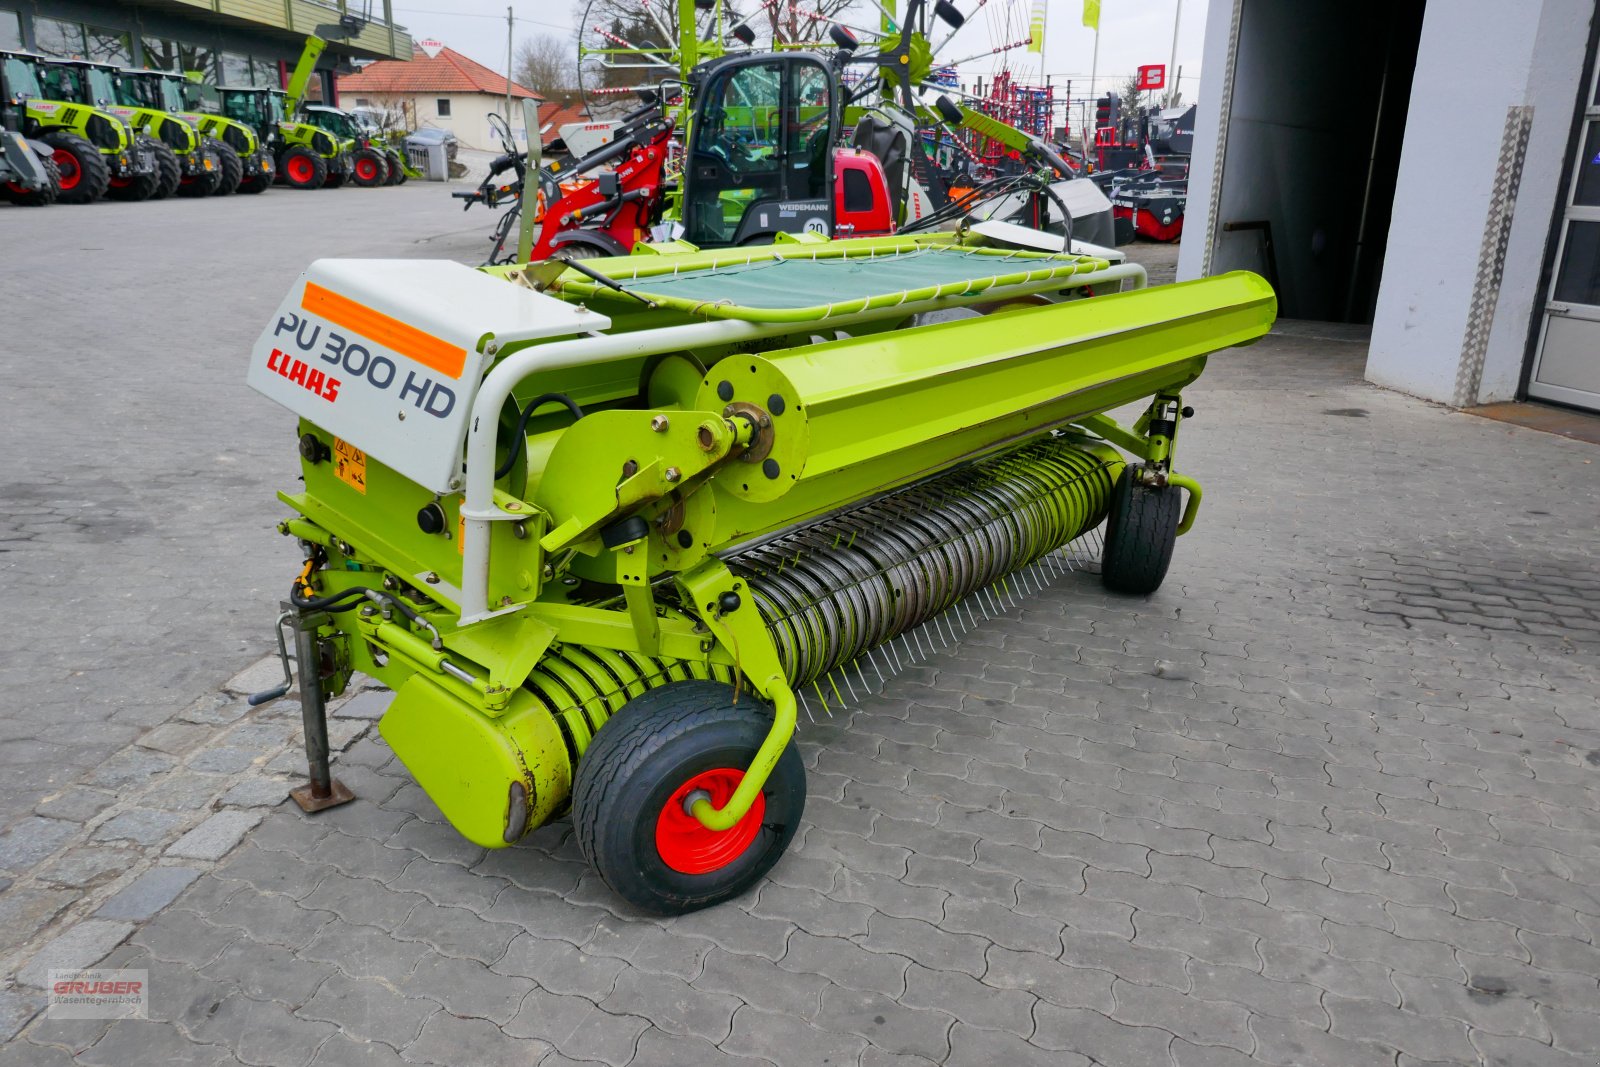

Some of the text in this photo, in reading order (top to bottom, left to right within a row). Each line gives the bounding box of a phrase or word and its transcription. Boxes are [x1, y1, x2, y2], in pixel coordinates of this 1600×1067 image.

[913, 192, 921, 220] CLAA
[809, 224, 823, 234] 20
[266, 348, 341, 403] CLAAS
[274, 312, 456, 419] PU 300 HD
